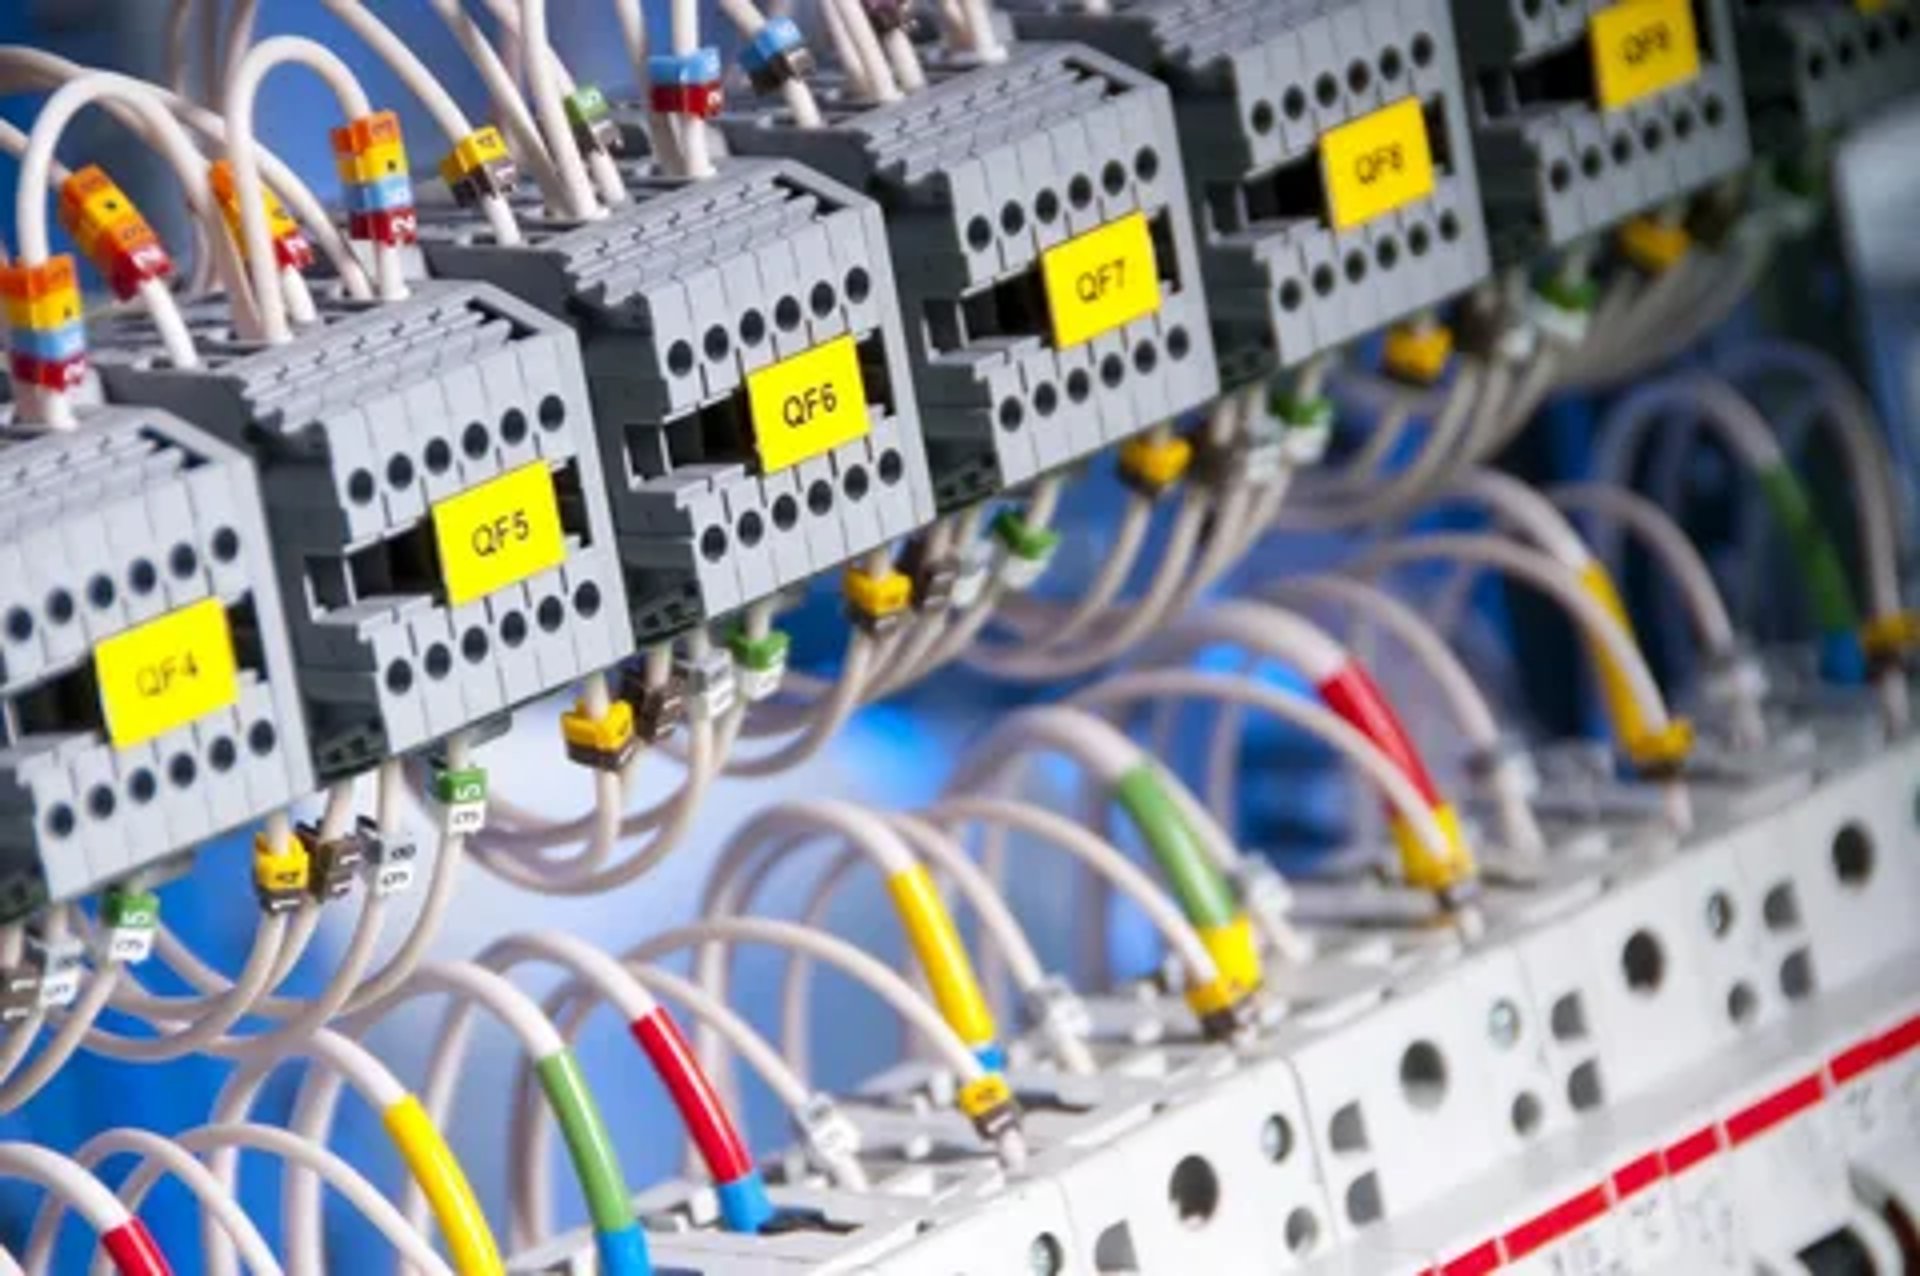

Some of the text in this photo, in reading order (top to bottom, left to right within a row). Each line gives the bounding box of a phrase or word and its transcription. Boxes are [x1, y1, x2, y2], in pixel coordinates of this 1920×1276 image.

[1076, 257, 1127, 303] QF7
[782, 382, 838, 430] QF6
[470, 508, 530, 557] QF5
[135, 650, 201, 698] QF4
